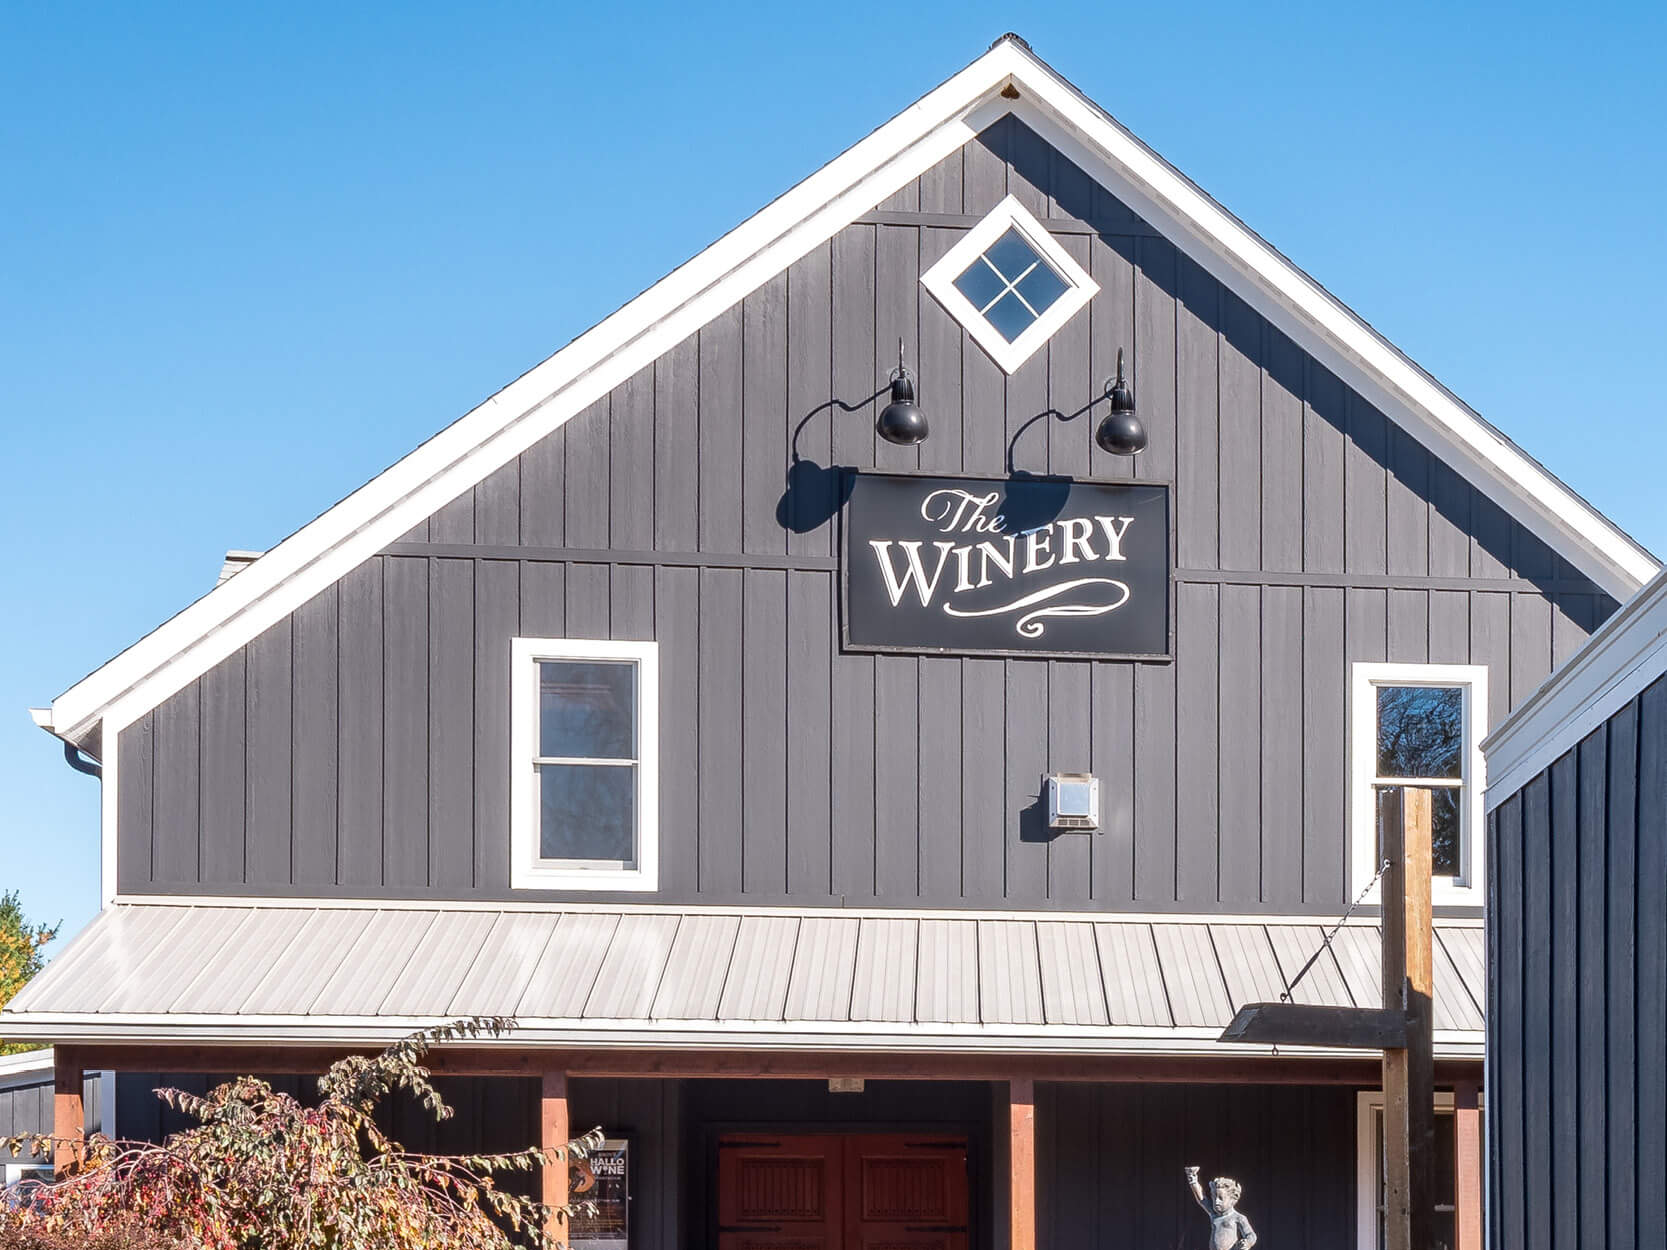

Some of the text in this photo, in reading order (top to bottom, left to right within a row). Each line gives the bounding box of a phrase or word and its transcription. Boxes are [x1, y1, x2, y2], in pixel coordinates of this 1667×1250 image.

[921, 489, 1008, 533] The
[869, 515, 1134, 607] WINERY
[590, 1158, 624, 1166] HALLO
